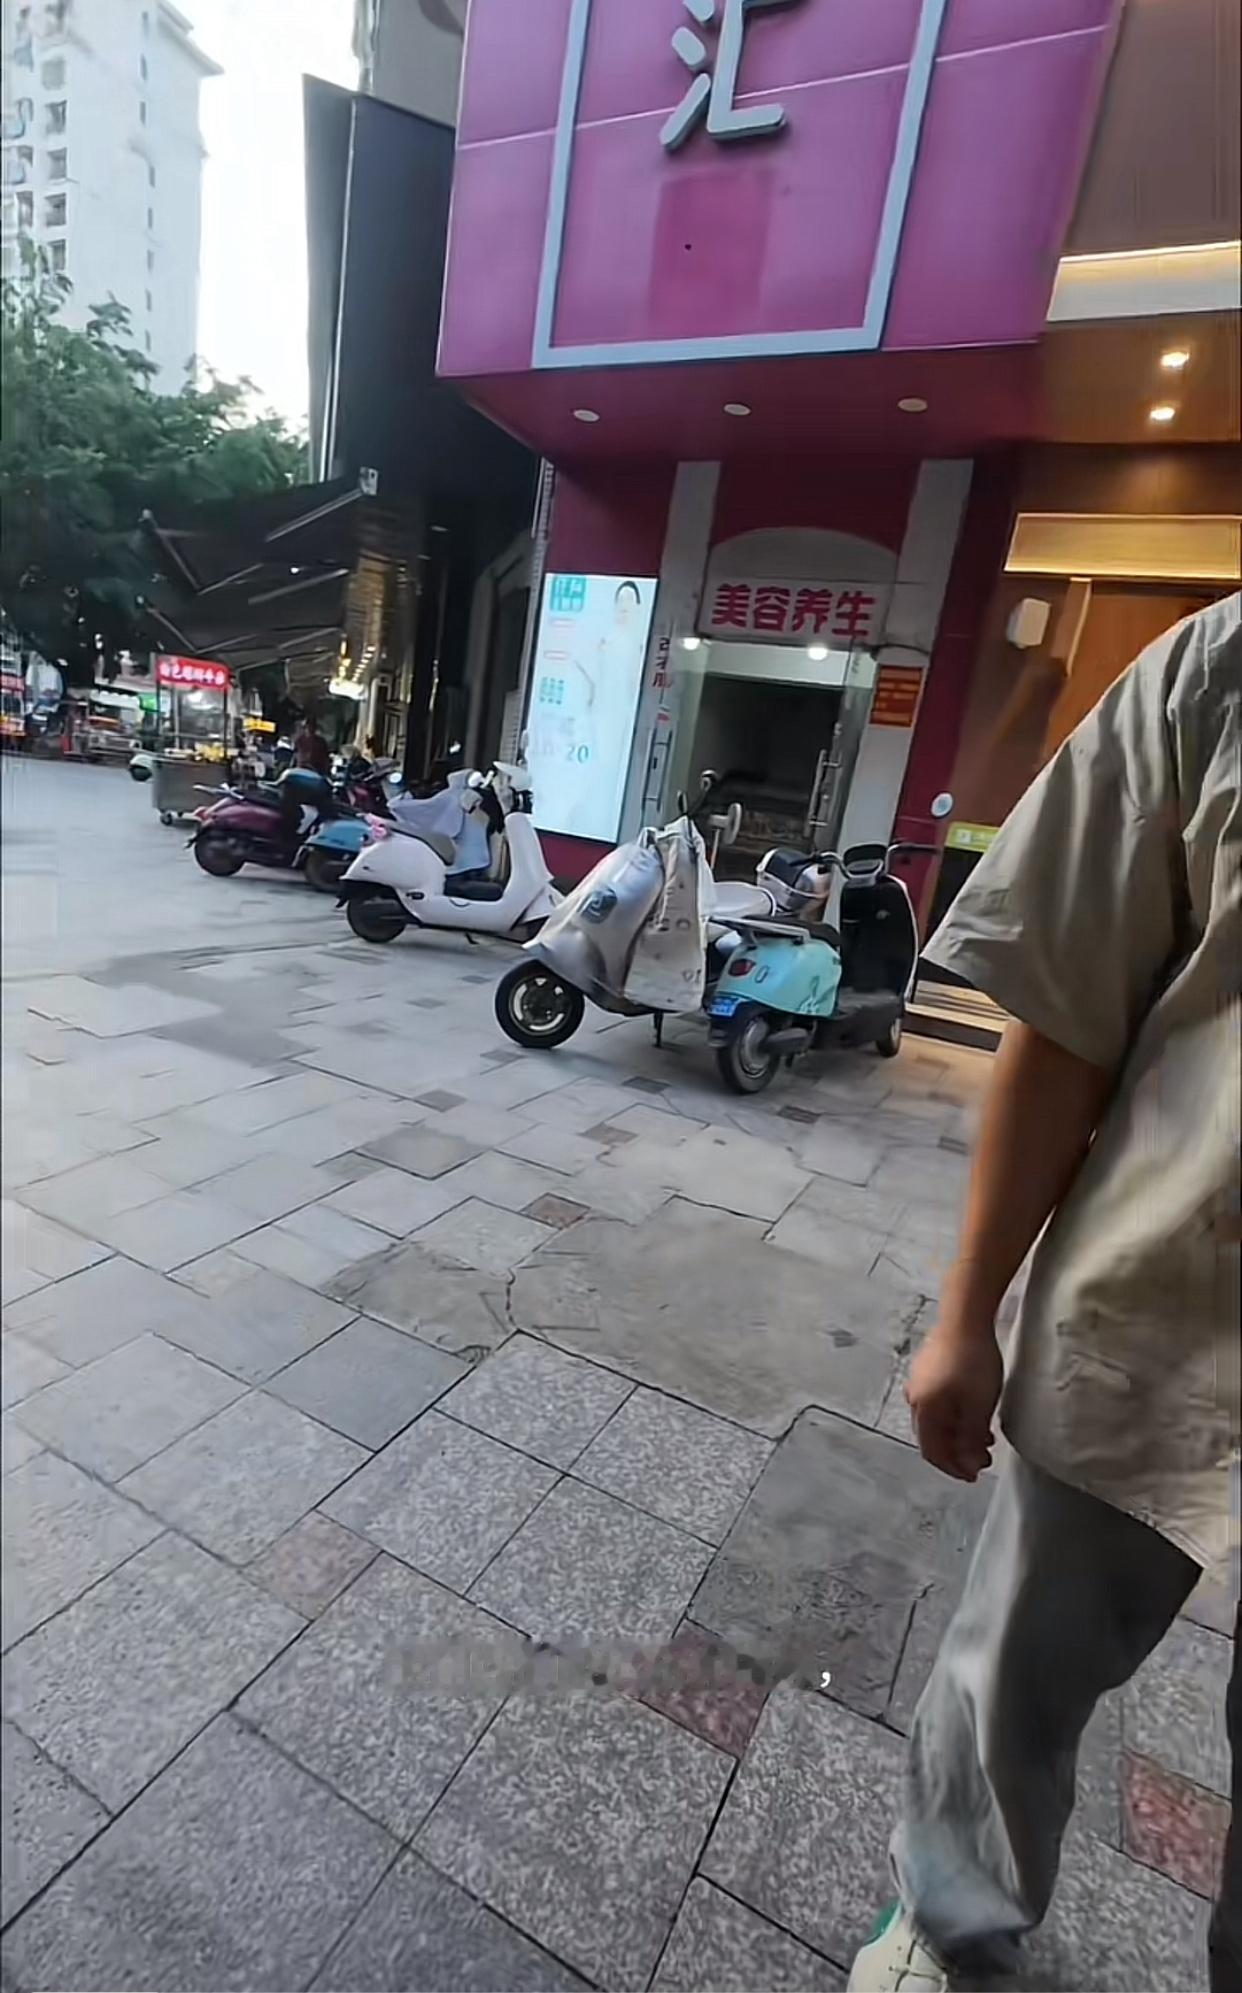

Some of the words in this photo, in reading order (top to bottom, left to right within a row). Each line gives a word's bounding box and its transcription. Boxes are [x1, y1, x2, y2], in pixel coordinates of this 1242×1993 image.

[659, 0, 806, 152] 汇
[711, 583, 876, 637] 美容养生
